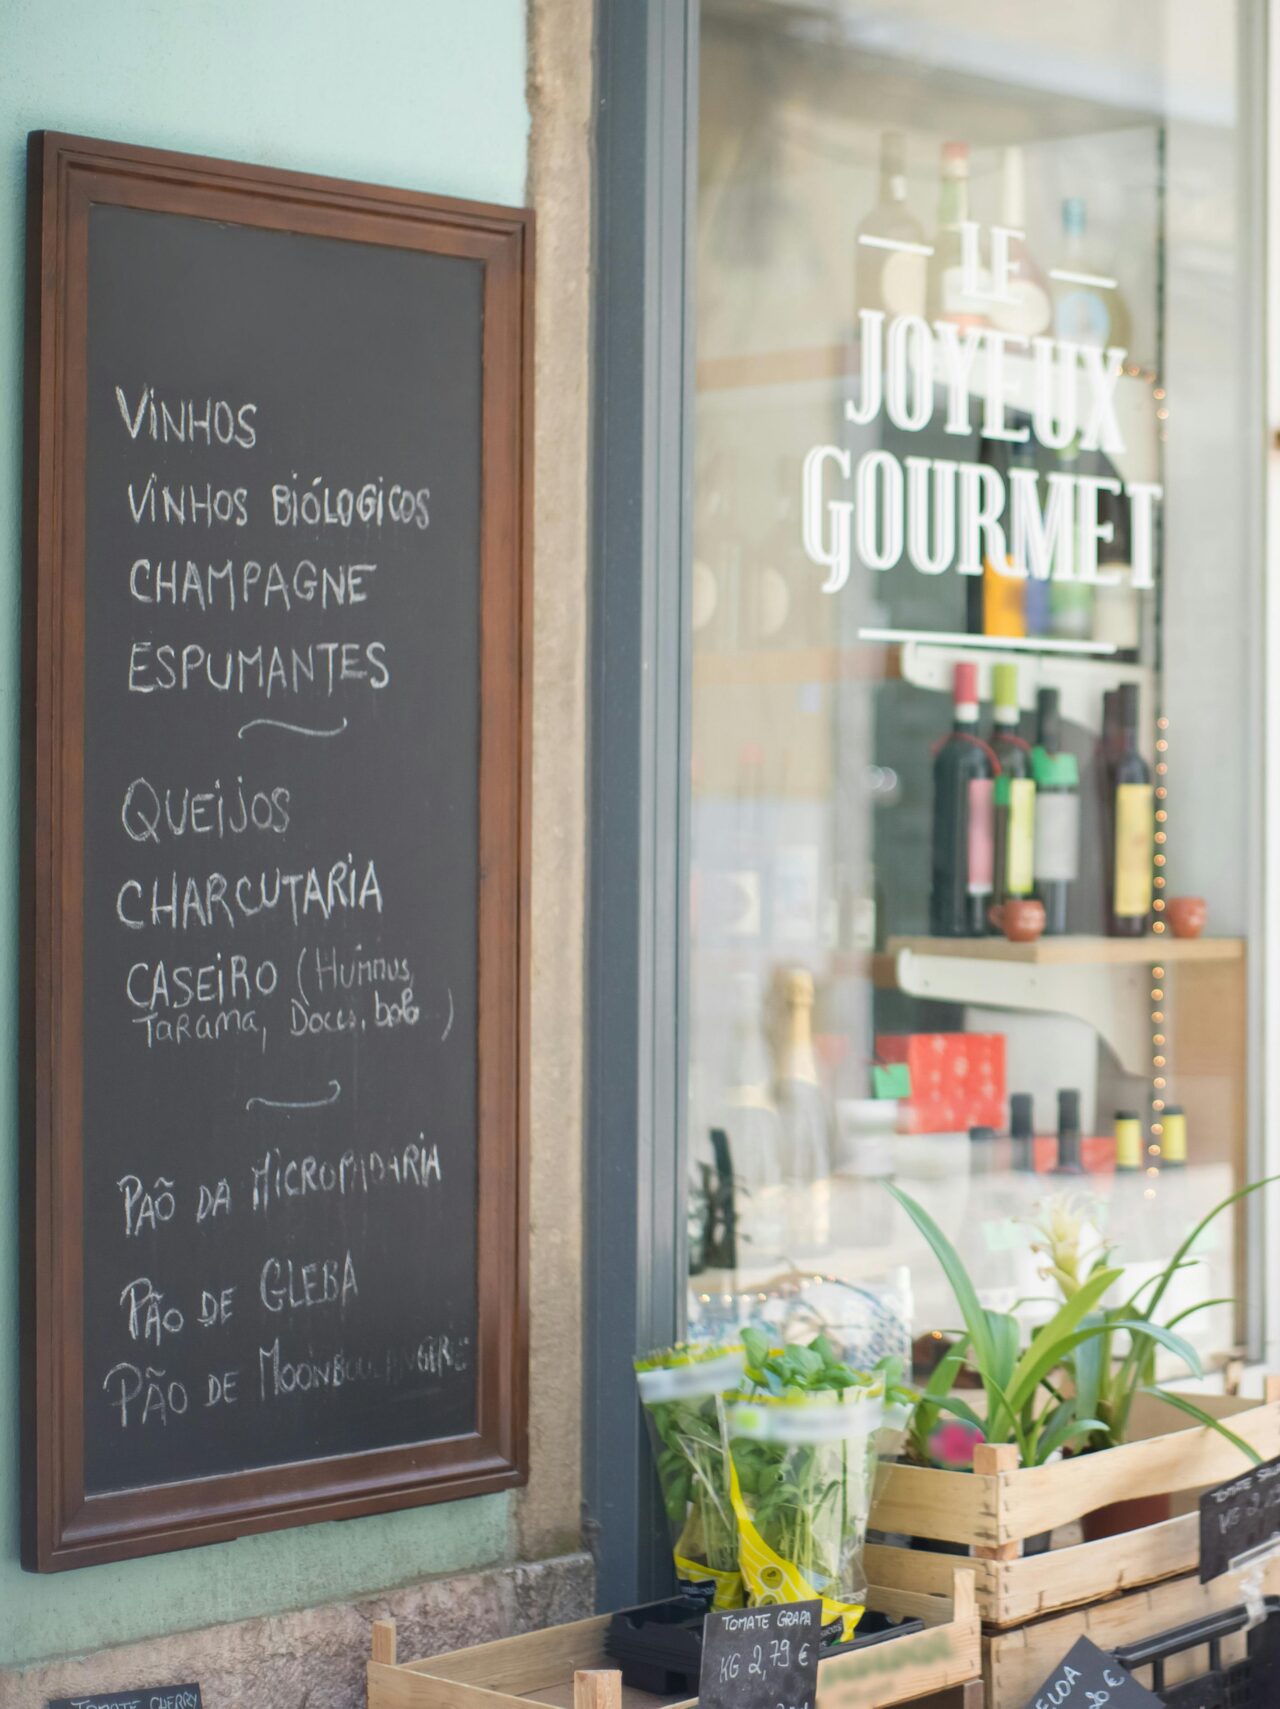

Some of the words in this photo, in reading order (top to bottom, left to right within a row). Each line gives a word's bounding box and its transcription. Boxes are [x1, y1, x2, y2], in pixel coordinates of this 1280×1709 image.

[958, 220, 1027, 303] LE
[845, 307, 1129, 454] JOYEUX
[115, 383, 258, 448] VINHOS
[128, 472, 248, 528] VINHOS
[801, 445, 1164, 594] GOURMET
[129, 558, 377, 611] CHAMPAGNE
[128, 641, 391, 699] ESPUMANTES
[121, 775, 291, 843] QUEIJOS
[116, 852, 384, 930] CHARCUTARIA
[126, 952, 278, 1010] CASEIRO
[196, 1176, 231, 1224] DA
[119, 1277, 185, 1347] PÃO
[197, 1285, 238, 1327] DE
[259, 1249, 359, 1312] GLEBA
[103, 1362, 189, 1427] PÃO
[203, 1370, 240, 1407] DE
[721, 1612, 772, 1631] TOMATE
[776, 1609, 812, 1627] GRAPA
[719, 1652, 742, 1683] KG
[798, 1643, 811, 1667] €
